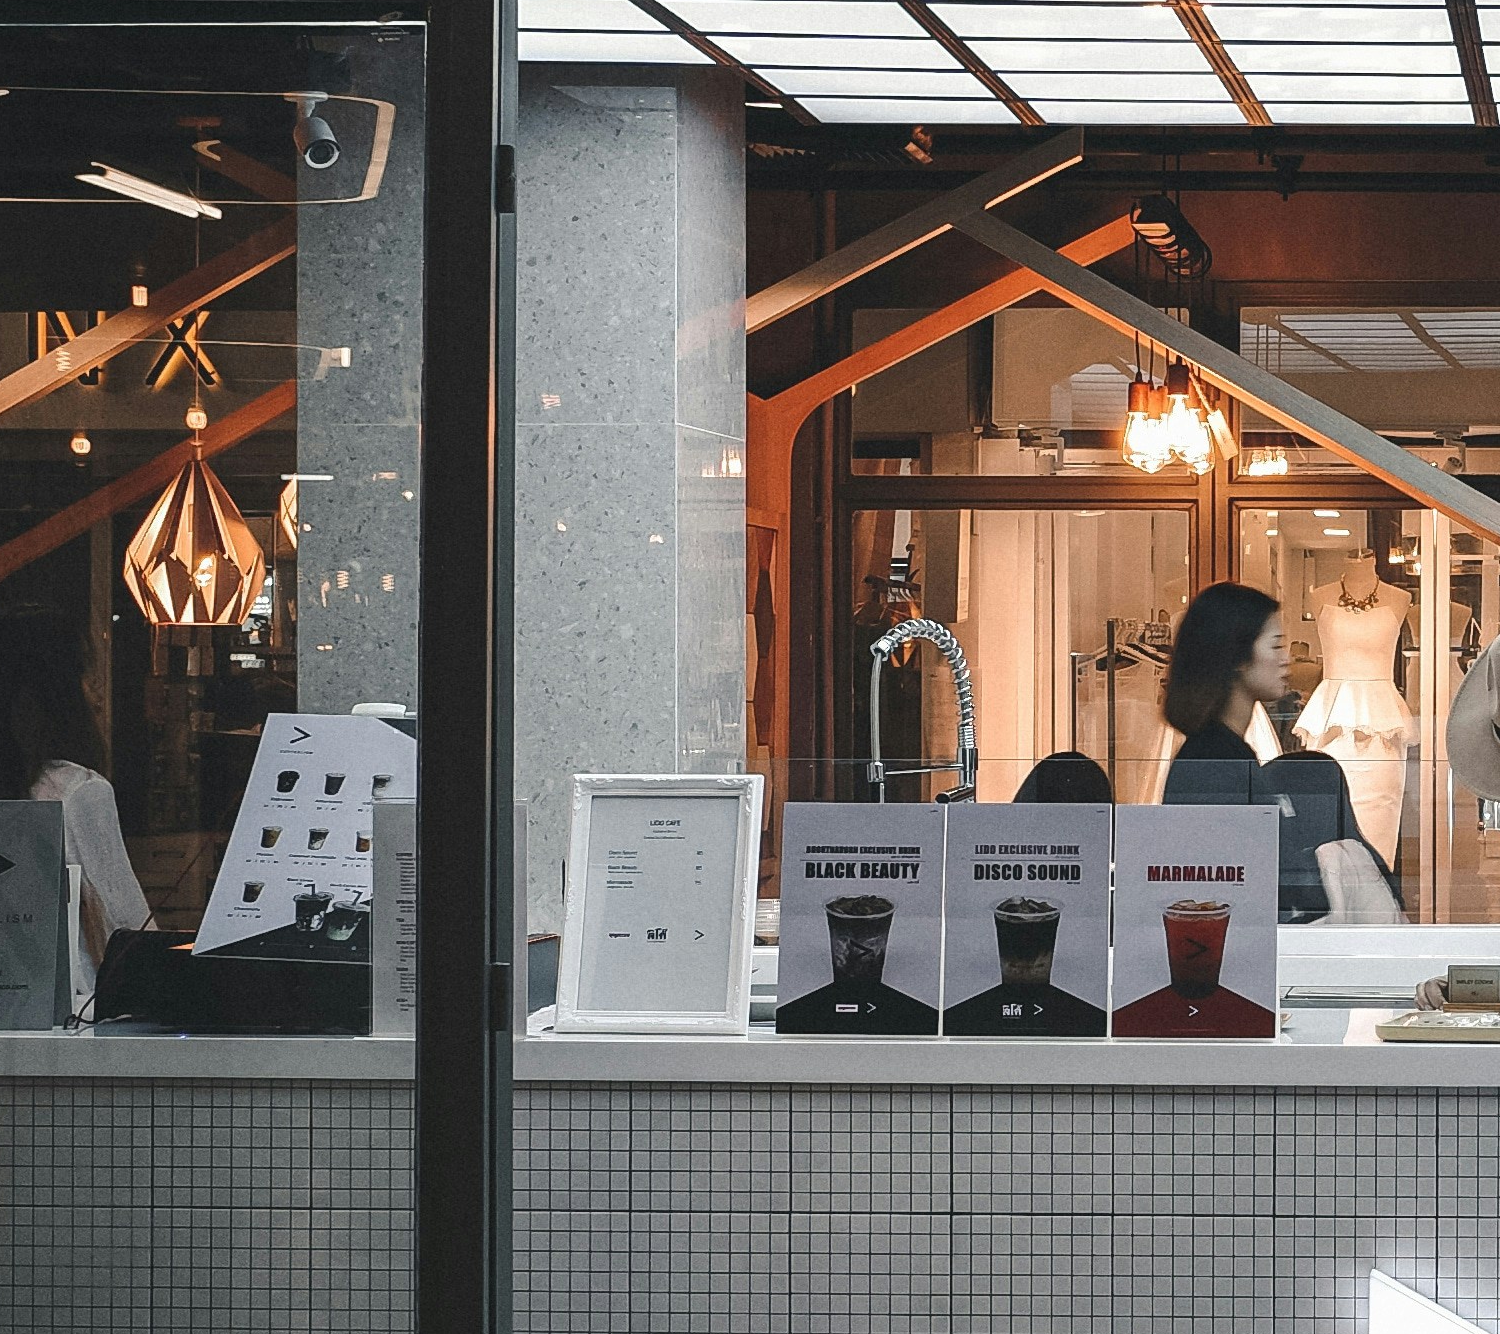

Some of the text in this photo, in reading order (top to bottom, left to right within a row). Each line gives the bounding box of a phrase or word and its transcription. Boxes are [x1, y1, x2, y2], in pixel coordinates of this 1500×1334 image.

[860, 846, 896, 855] EXCLUSIVE
[899, 846, 921, 855] DRINK
[974, 844, 1080, 855] LIDO EXCLUSIVE DRINK
[805, 862, 920, 879] BLACK BEAUTY
[973, 863, 1081, 881] DISCO SOUND
[1147, 865, 1245, 882] MARMALADE
